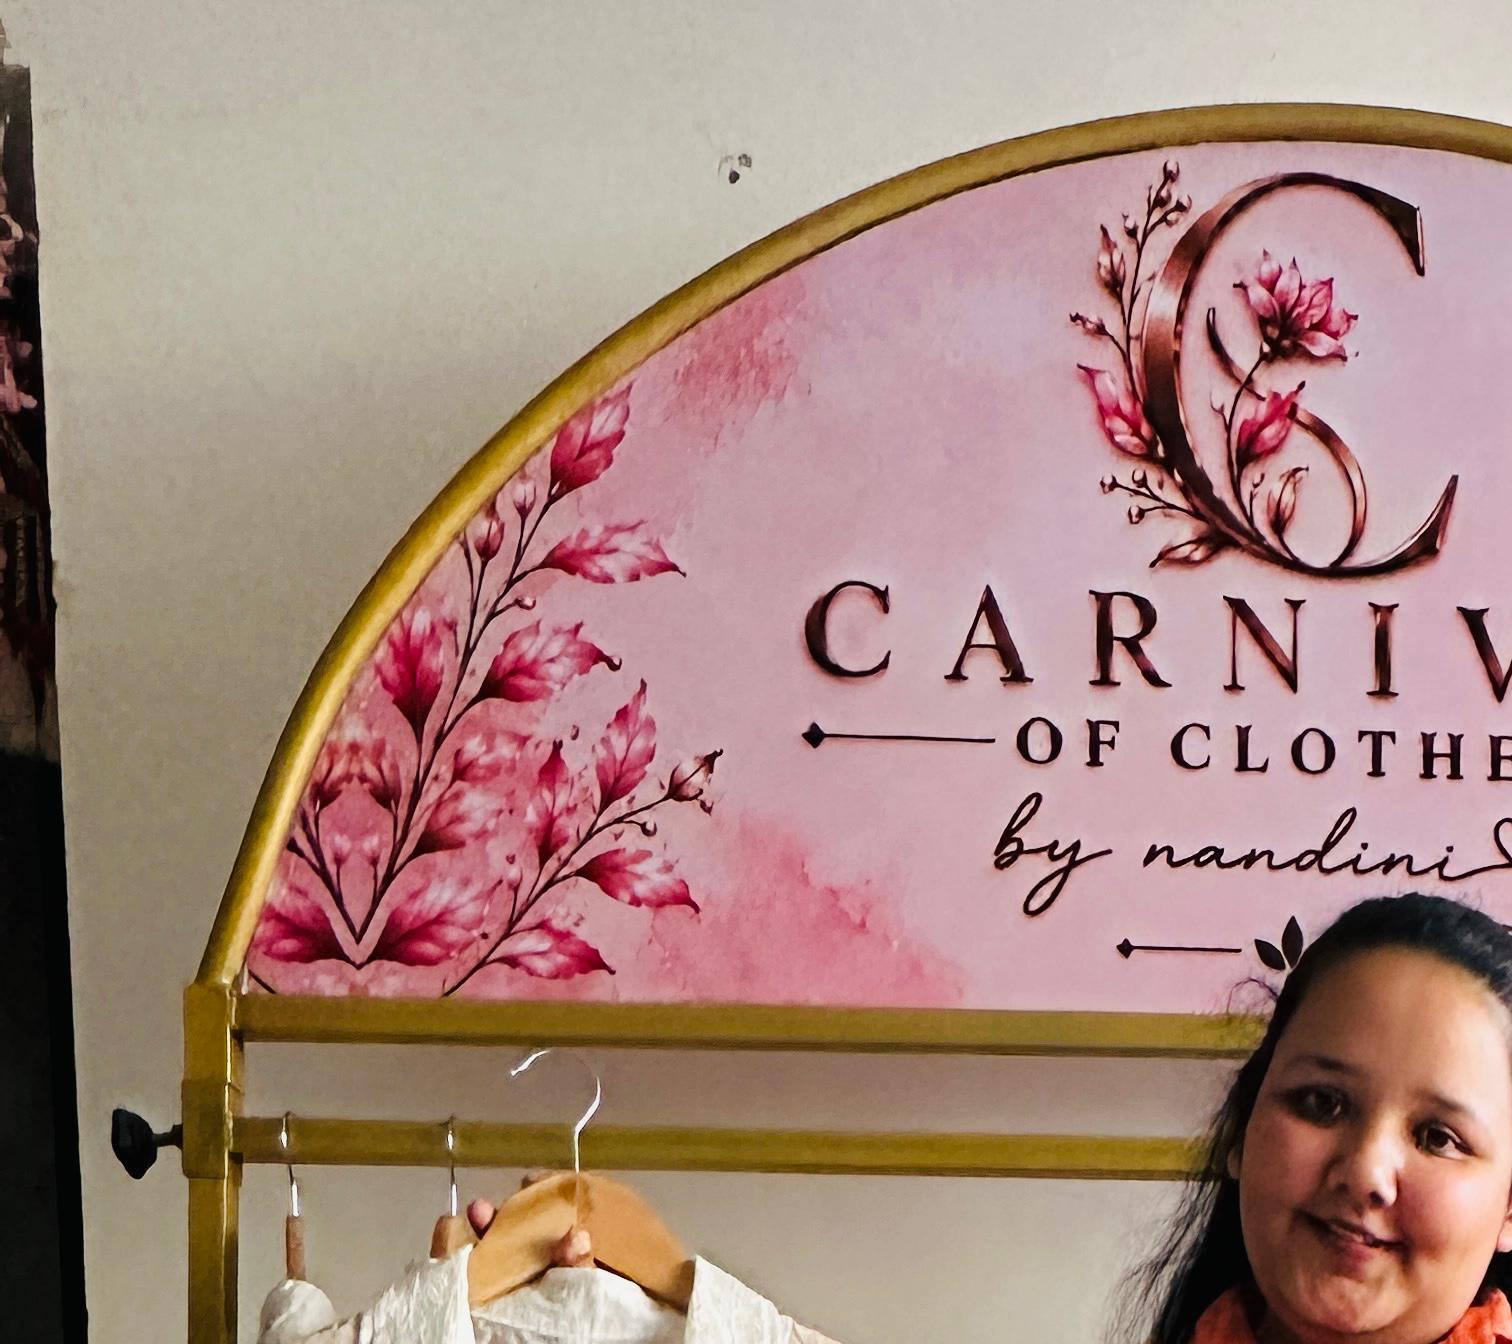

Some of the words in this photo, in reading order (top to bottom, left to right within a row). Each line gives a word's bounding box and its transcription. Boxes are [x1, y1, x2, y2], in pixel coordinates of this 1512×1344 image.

[1016, 717, 1121, 768] OF
[993, 792, 1113, 918] by
[1142, 807, 1490, 882] nandini
